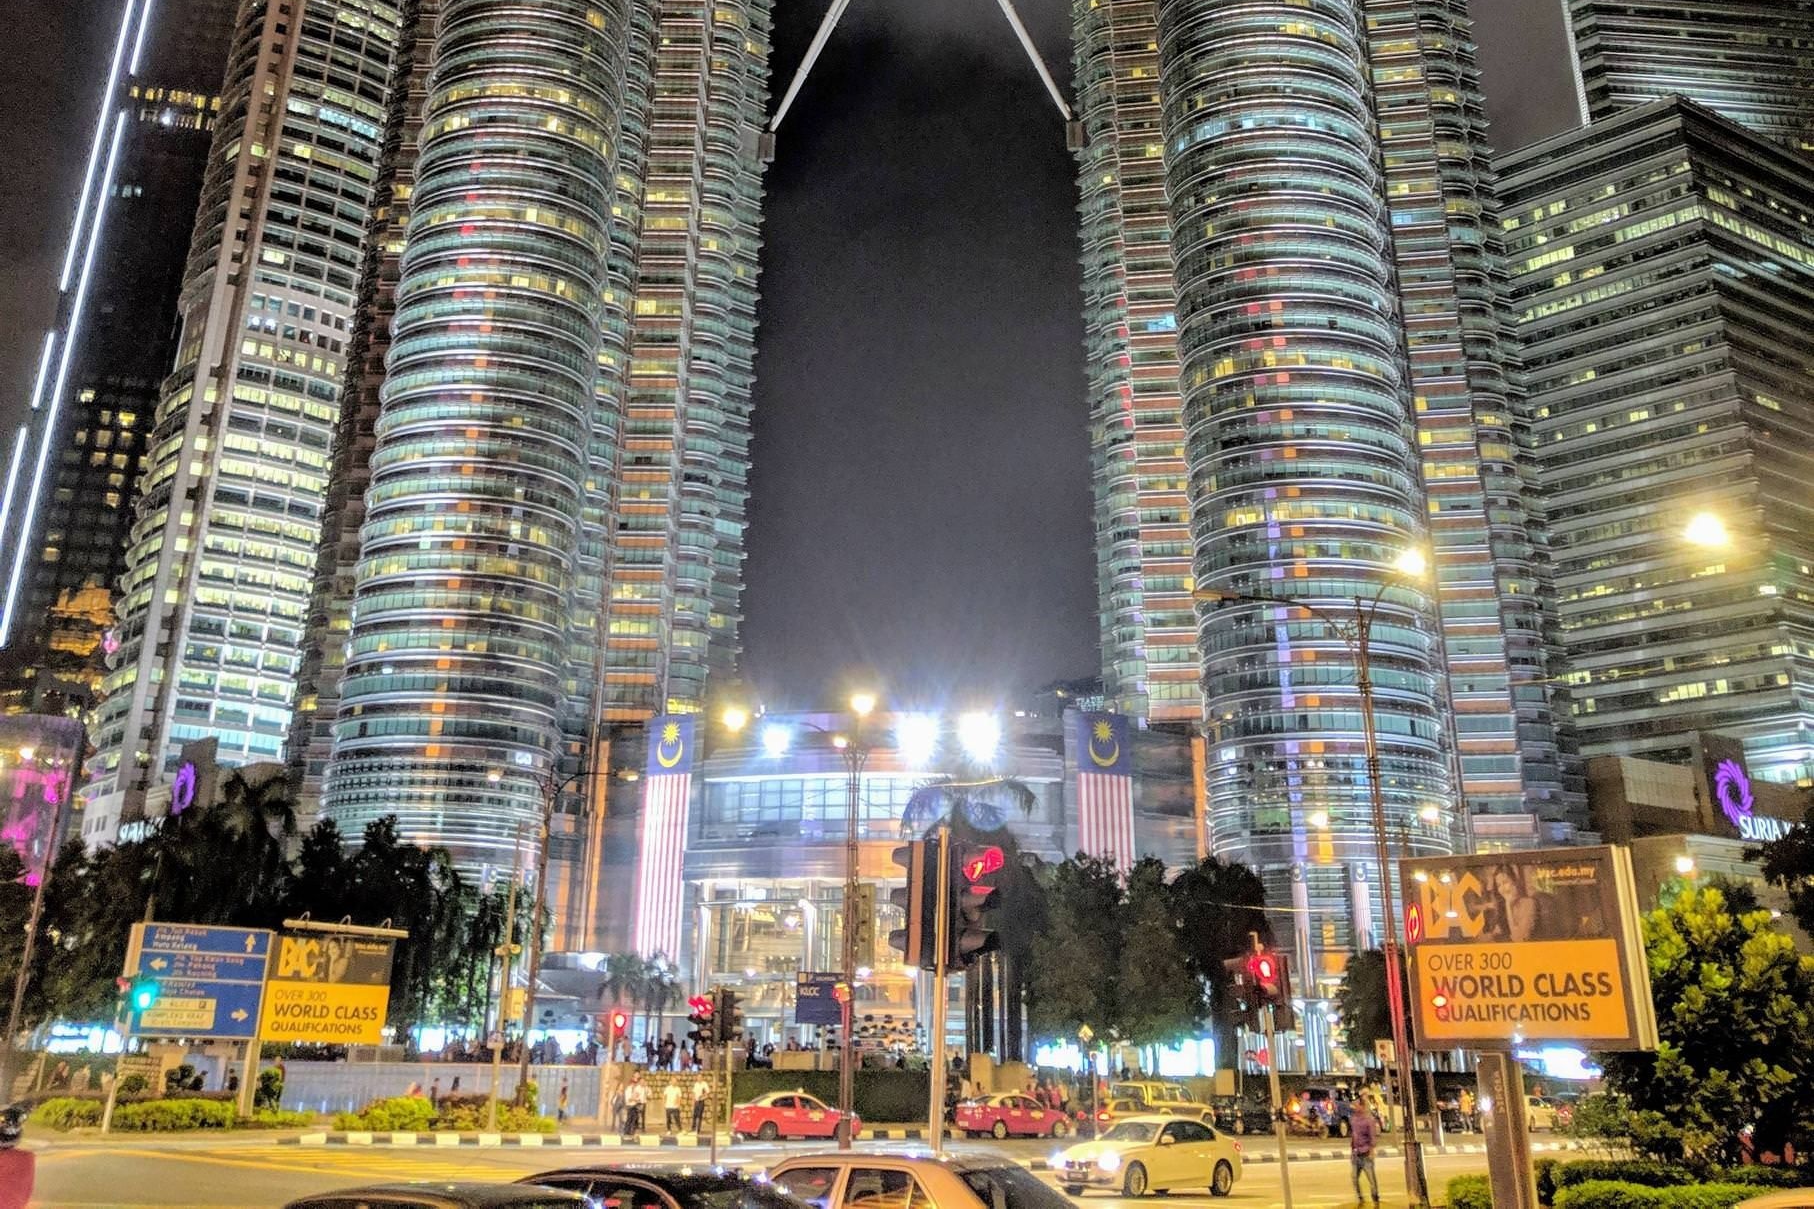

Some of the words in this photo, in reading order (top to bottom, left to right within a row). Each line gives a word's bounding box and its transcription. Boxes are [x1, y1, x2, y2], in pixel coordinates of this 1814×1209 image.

[1739, 816, 1782, 840] SURIA
[1428, 953, 1475, 971] OVER
[1479, 952, 1512, 970] 300
[1432, 975, 1525, 999] WORLD
[1533, 972, 1613, 998] CLASS
[274, 989, 304, 1001] OVER
[306, 991, 327, 1002] 300
[274, 1004, 330, 1019] WORLD
[334, 1006, 378, 1021] CLASS
[1435, 1003, 1592, 1022] QUALIFICATIONS
[271, 1021, 363, 1035] QUALIFICATIONS
